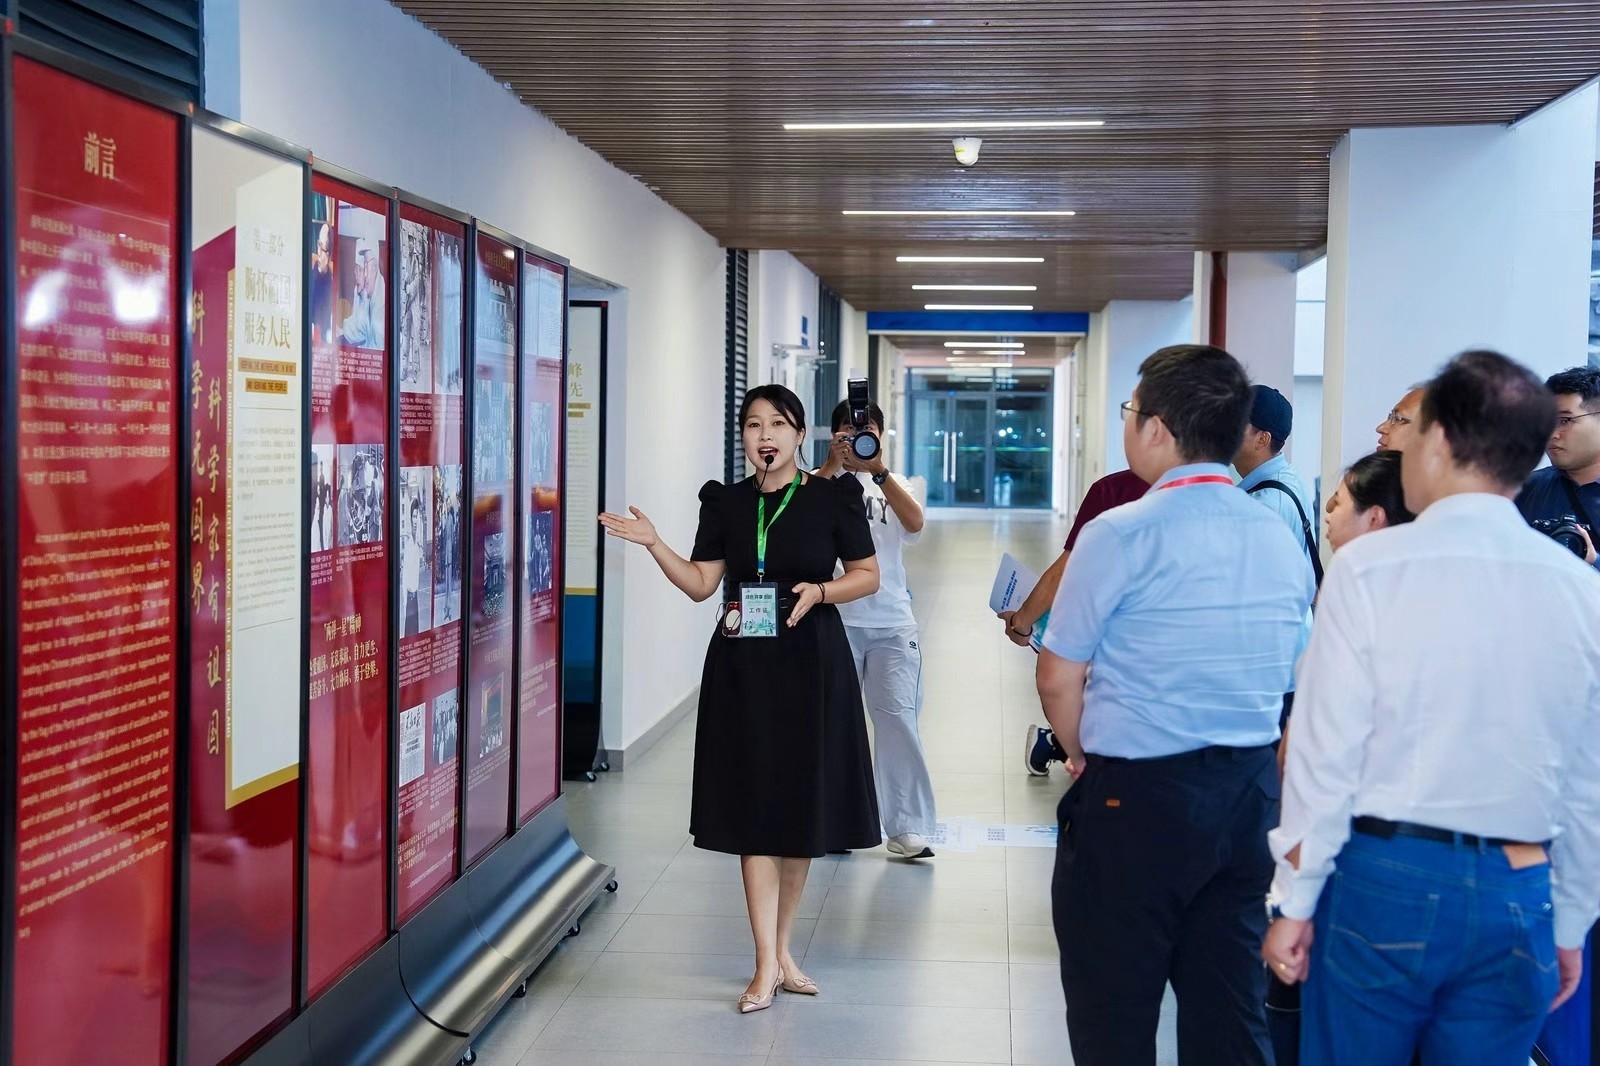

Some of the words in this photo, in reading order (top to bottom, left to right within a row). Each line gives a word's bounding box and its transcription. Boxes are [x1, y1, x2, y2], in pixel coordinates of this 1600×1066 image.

[83, 131, 117, 180] 前言
[245, 266, 291, 306] 胸怀祖国
[244, 311, 291, 350] 服务人民
